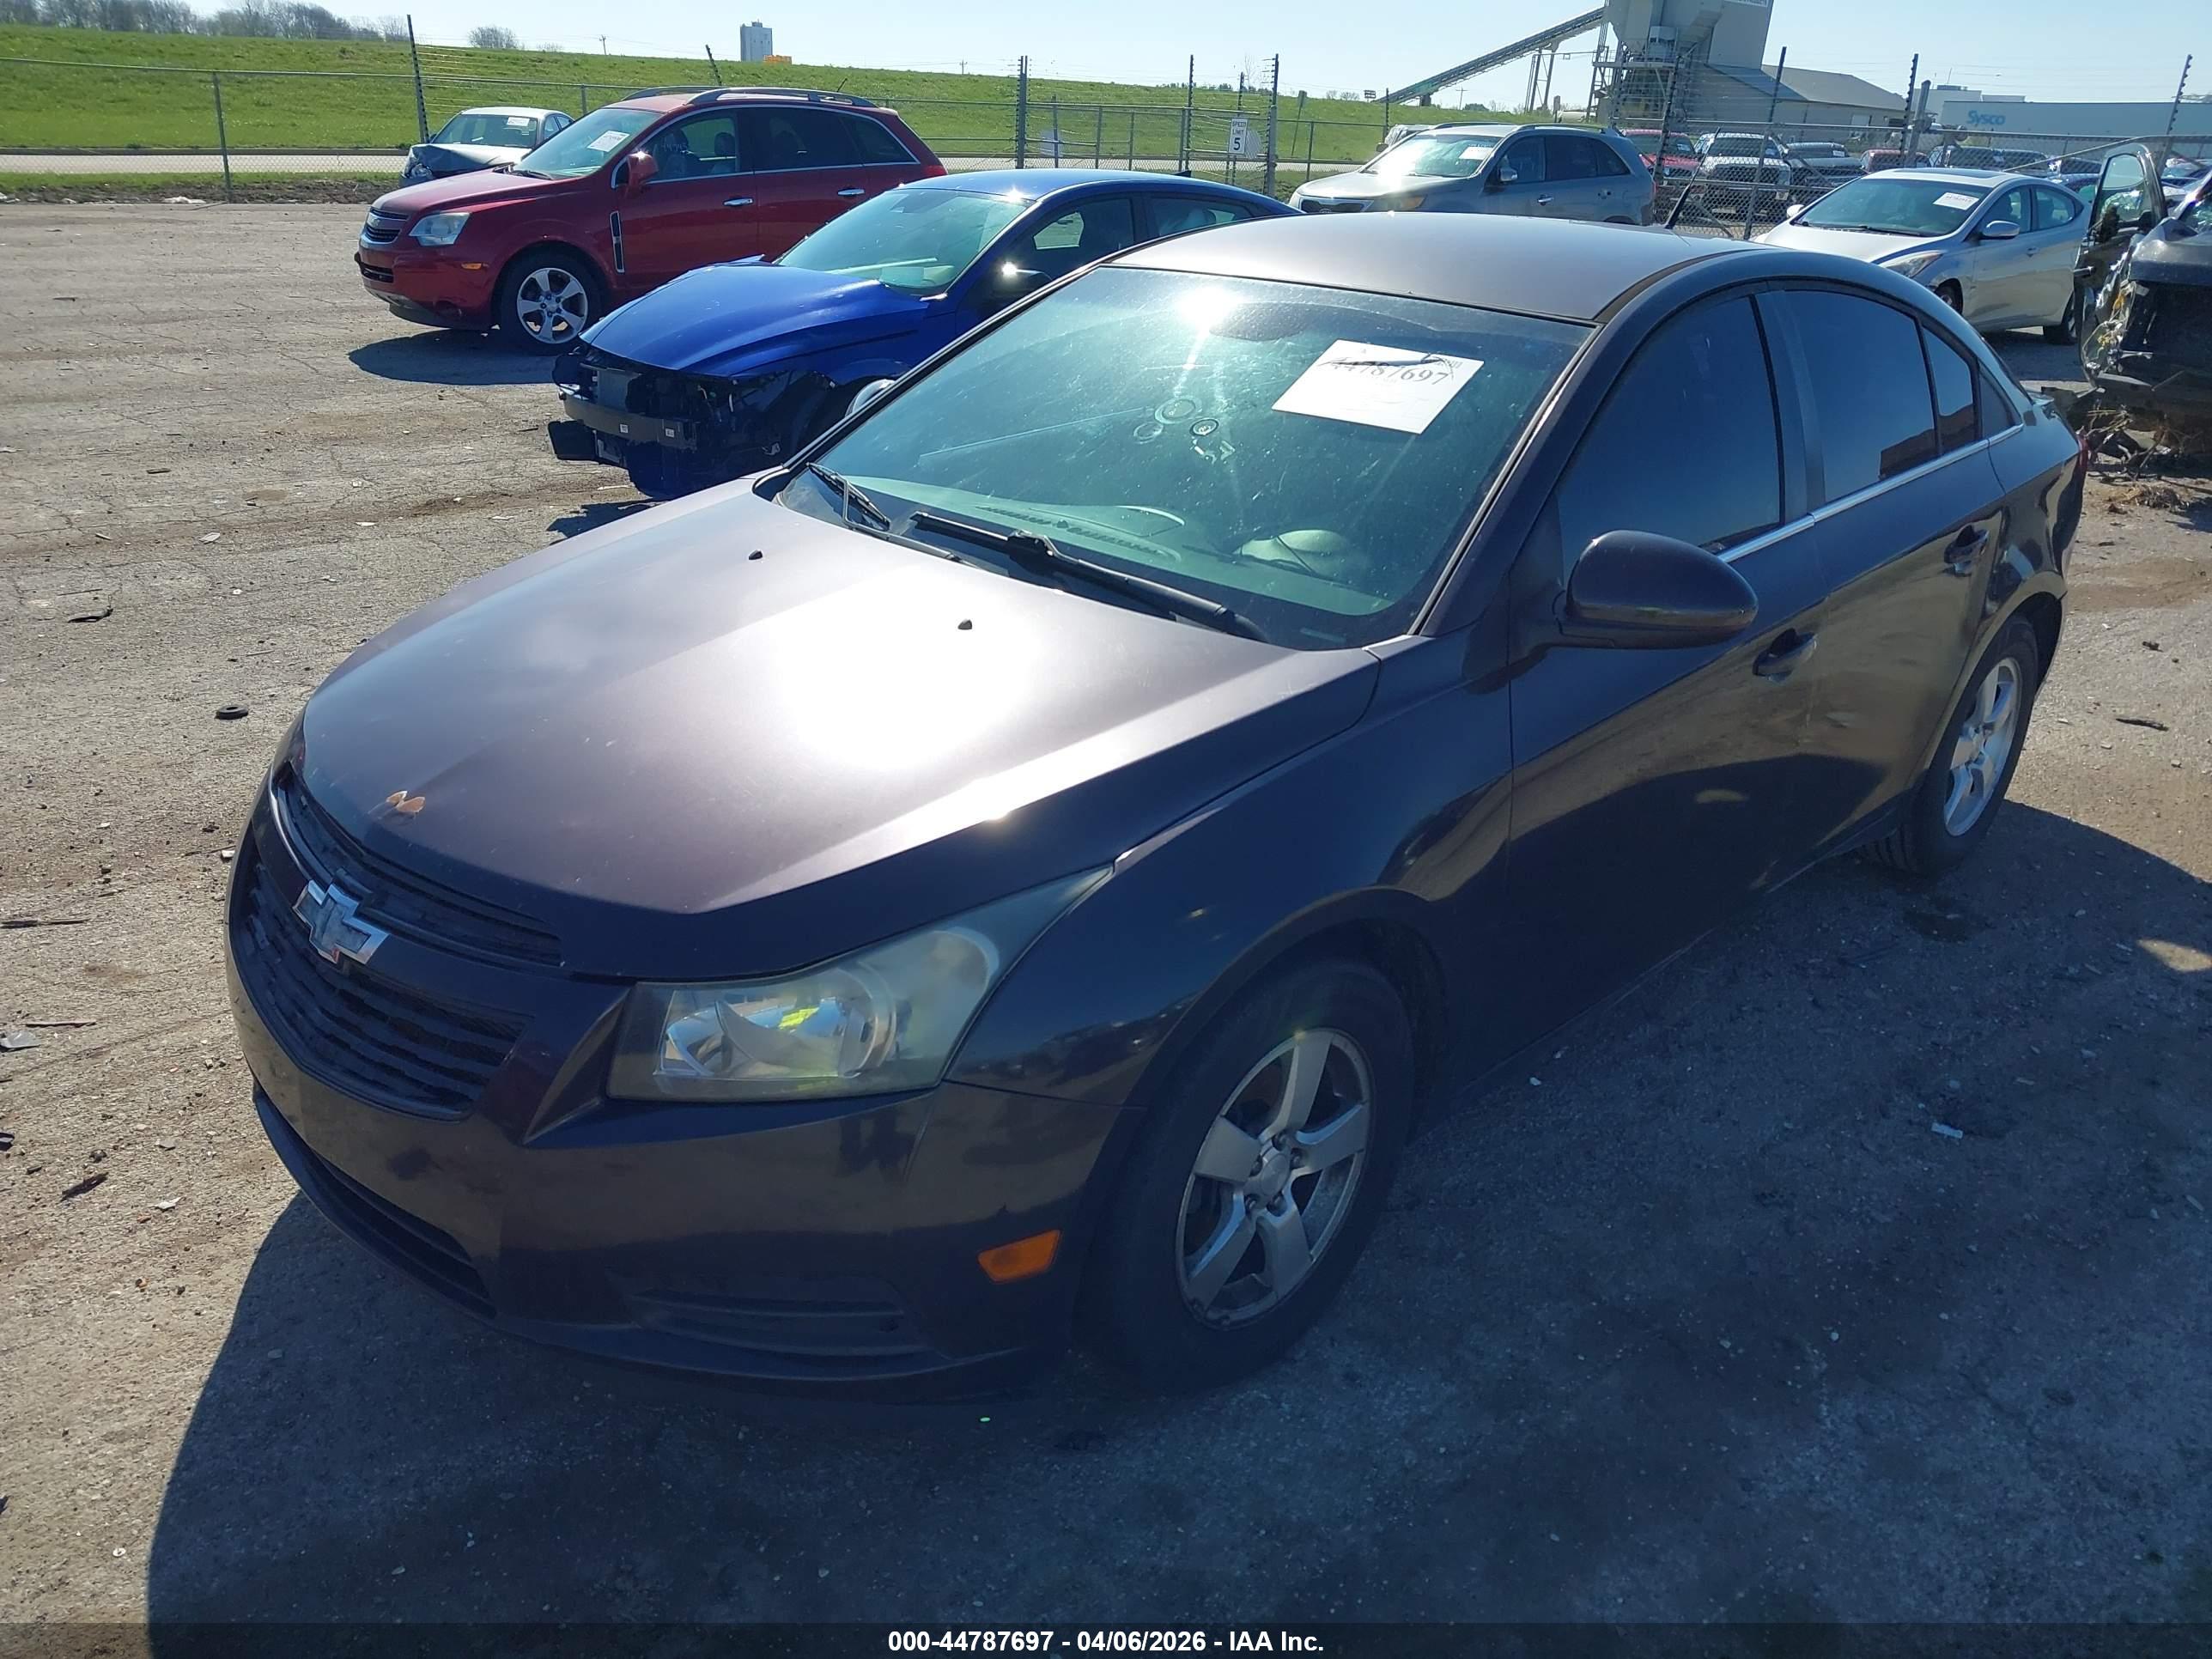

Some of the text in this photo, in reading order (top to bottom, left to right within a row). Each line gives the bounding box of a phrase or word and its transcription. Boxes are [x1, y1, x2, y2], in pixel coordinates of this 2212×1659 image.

[1967, 110, 2006, 125] Sysco
[1234, 137, 1241, 150] 5
[1331, 359, 1449, 386] 87697
